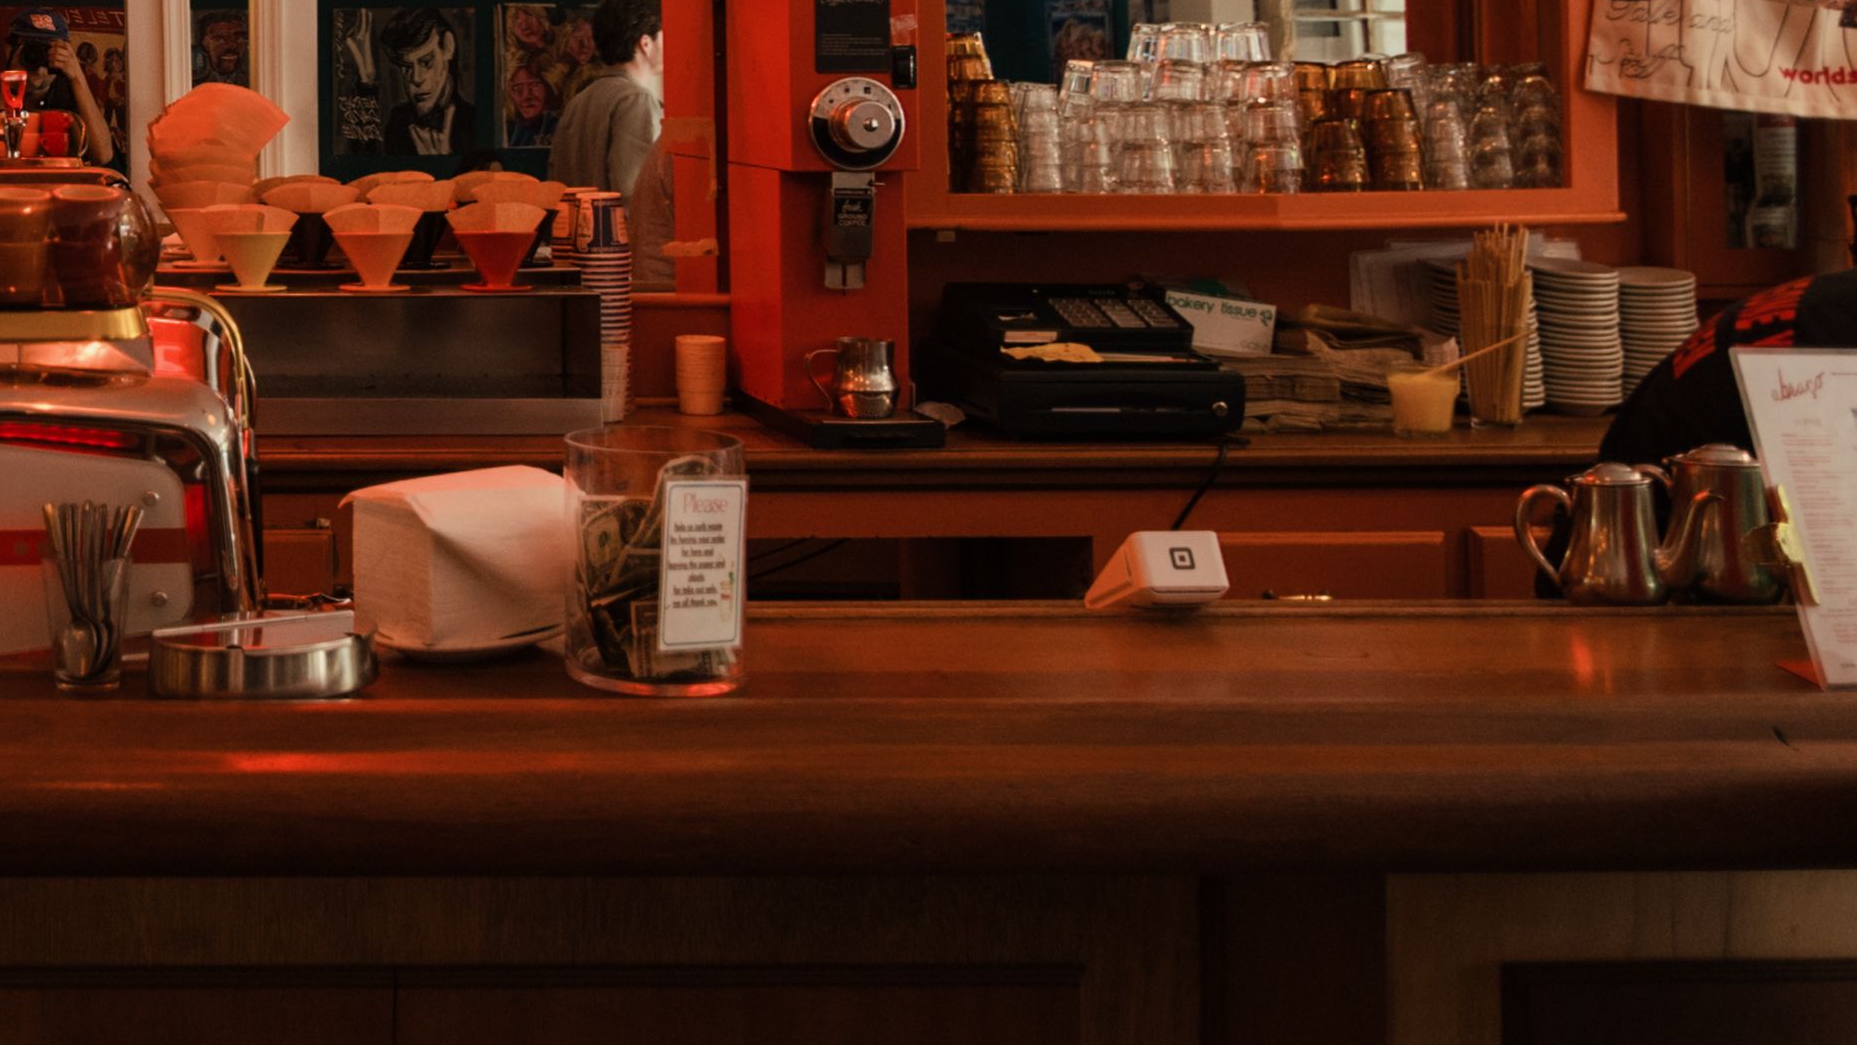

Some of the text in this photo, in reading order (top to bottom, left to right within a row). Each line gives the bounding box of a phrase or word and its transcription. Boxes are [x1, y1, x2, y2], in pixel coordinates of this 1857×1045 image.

[1166, 295, 1257, 318] bakery tissue
[683, 492, 729, 514] Please
